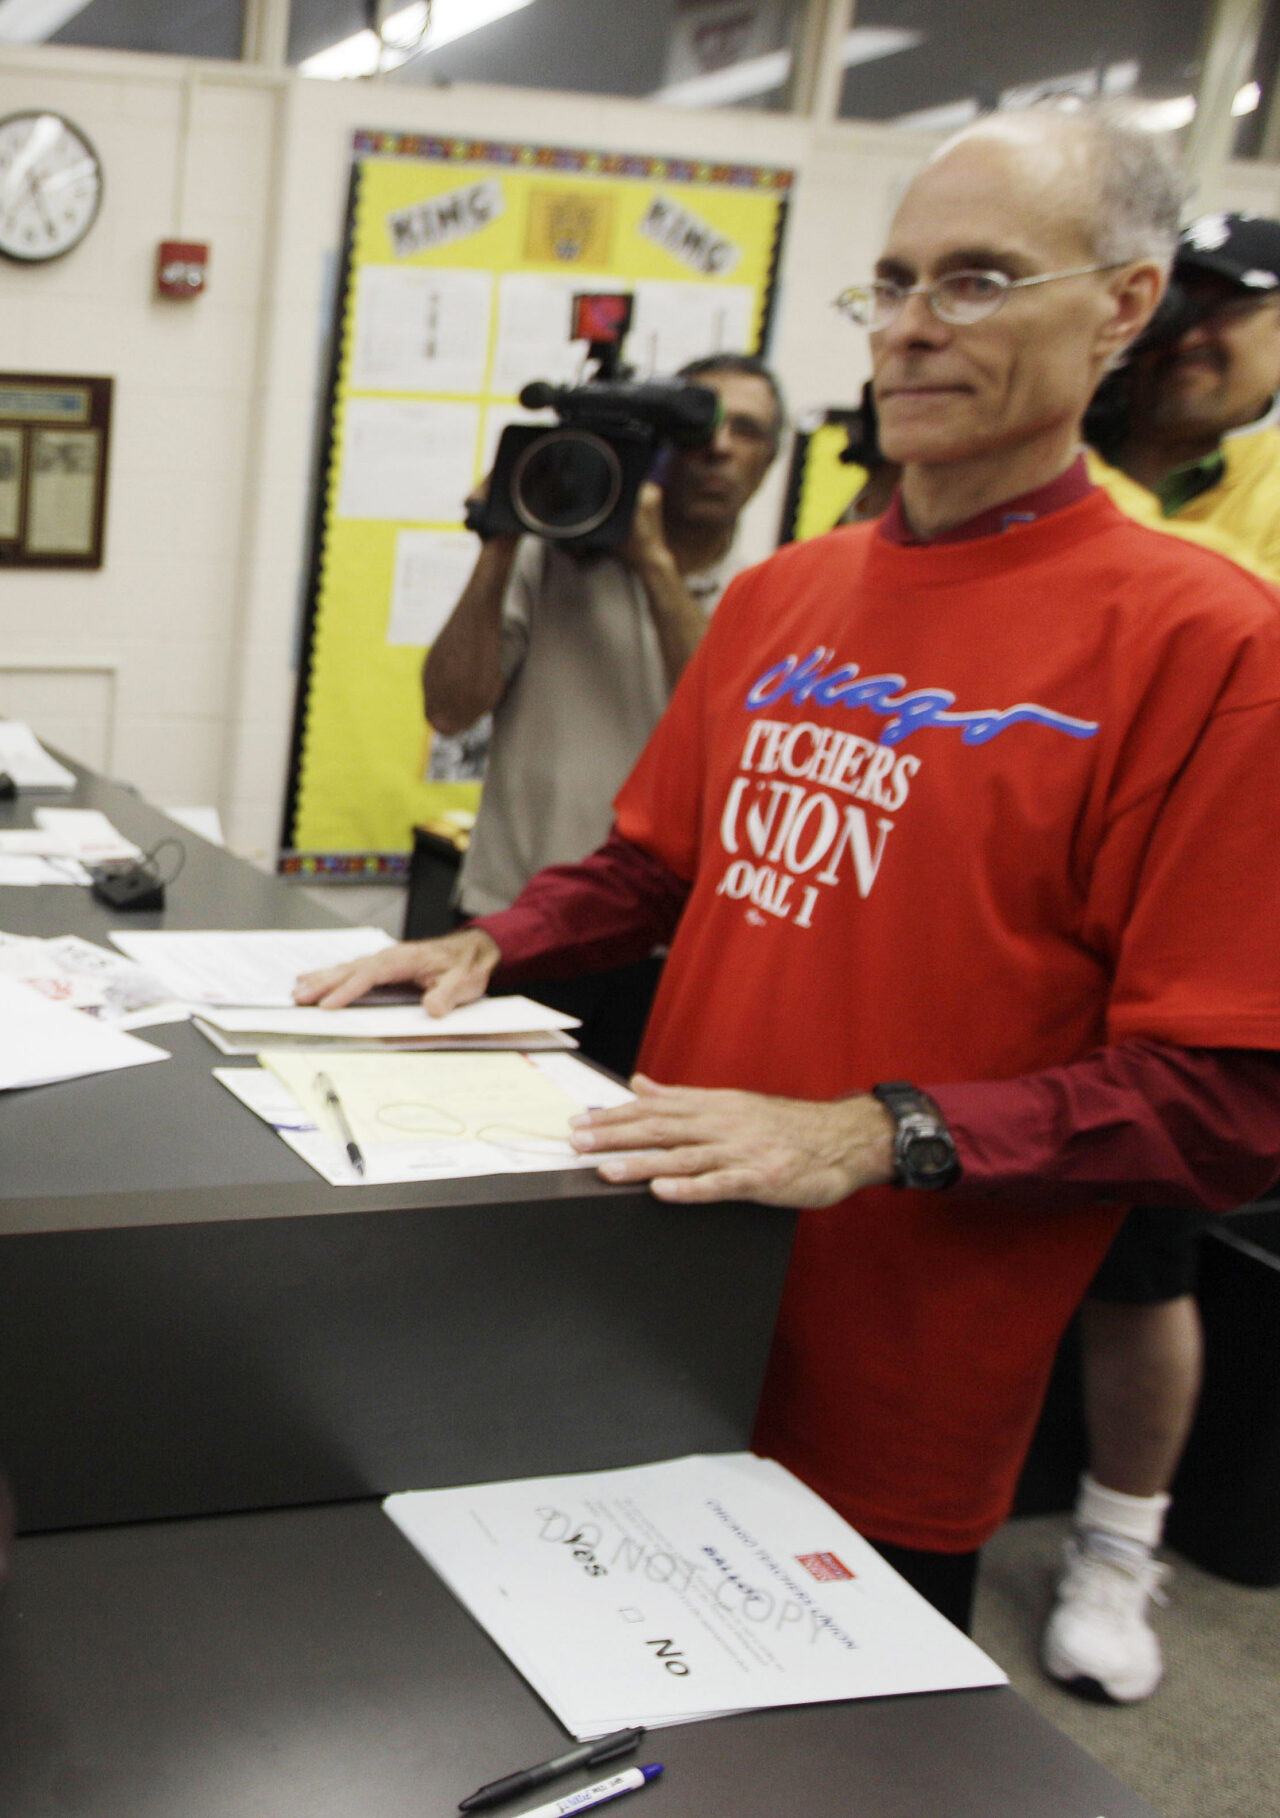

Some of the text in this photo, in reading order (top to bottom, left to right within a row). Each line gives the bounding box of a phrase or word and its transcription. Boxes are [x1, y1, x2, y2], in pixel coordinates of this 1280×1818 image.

[744, 646, 1100, 746] Chicago
[793, 886, 819, 929] 1
[563, 1532, 691, 1676] Yes No
[701, 1546, 762, 1602] BALLOT
[713, 1577, 830, 1643] COPY
